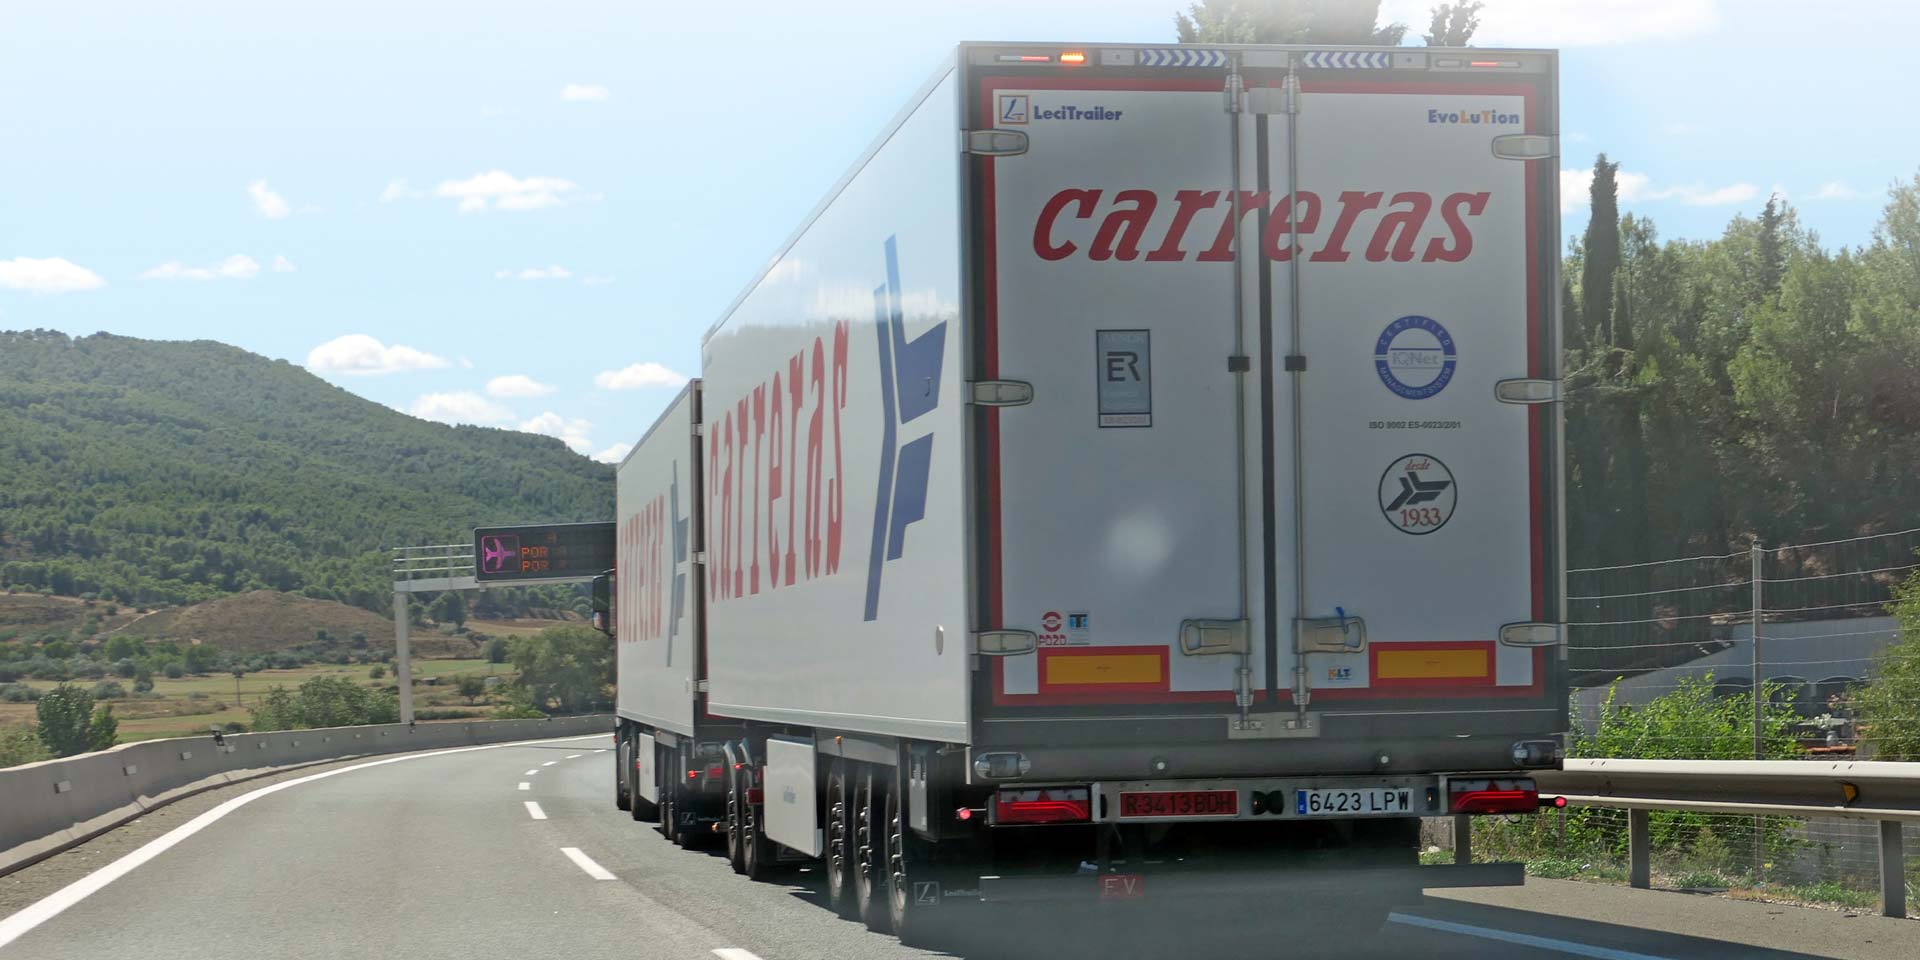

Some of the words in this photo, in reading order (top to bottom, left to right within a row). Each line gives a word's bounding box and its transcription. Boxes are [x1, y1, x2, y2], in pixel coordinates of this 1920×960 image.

[1034, 105, 1122, 121] LeciTrailer
[1428, 109, 1519, 124] EvoLuTion
[1032, 187, 1491, 263] carreras
[1107, 351, 1141, 382] ER
[1368, 421, 1385, 430] ISO
[708, 319, 849, 604] carreras
[1400, 507, 1441, 528] 1933
[1310, 792, 1361, 812] 6423
[1370, 791, 1409, 811] LPW
